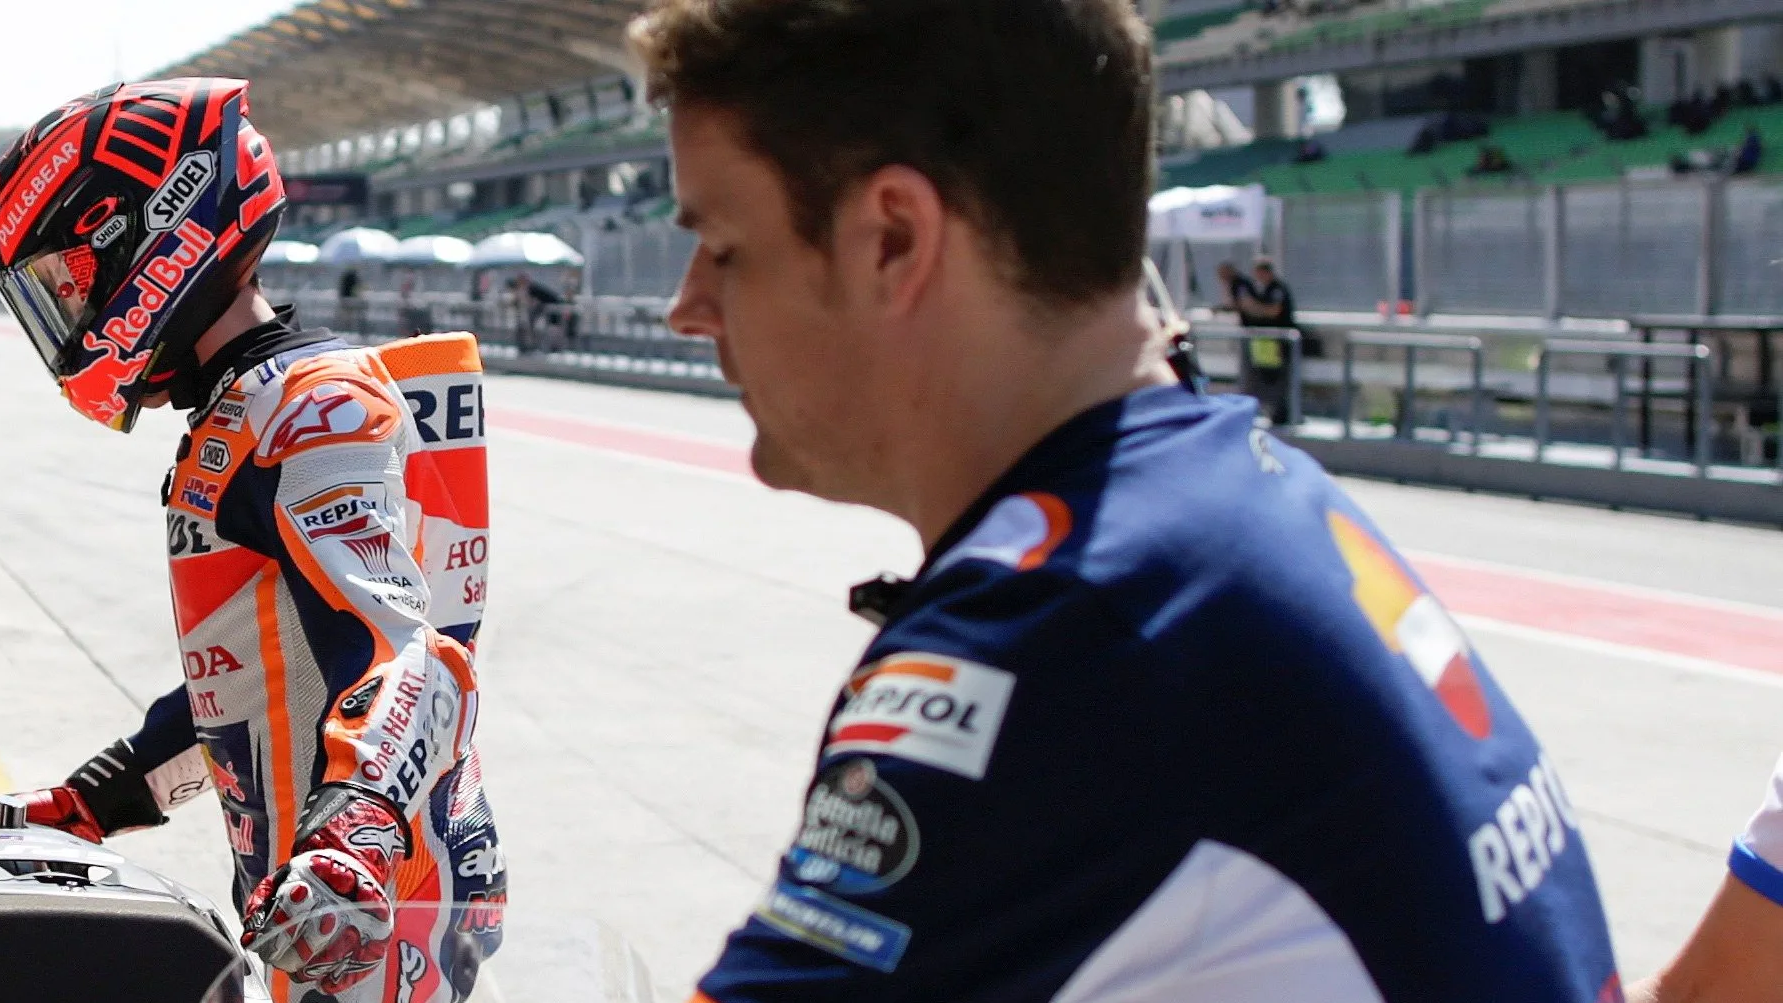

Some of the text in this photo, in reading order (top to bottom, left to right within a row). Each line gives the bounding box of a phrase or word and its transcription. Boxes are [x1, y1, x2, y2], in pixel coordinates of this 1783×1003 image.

[153, 160, 209, 224] SHOEI
[95, 216, 125, 246] SHOEI
[101, 274, 168, 352] Red
[145, 217, 217, 293] Bull
[360, 740, 397, 782] One
